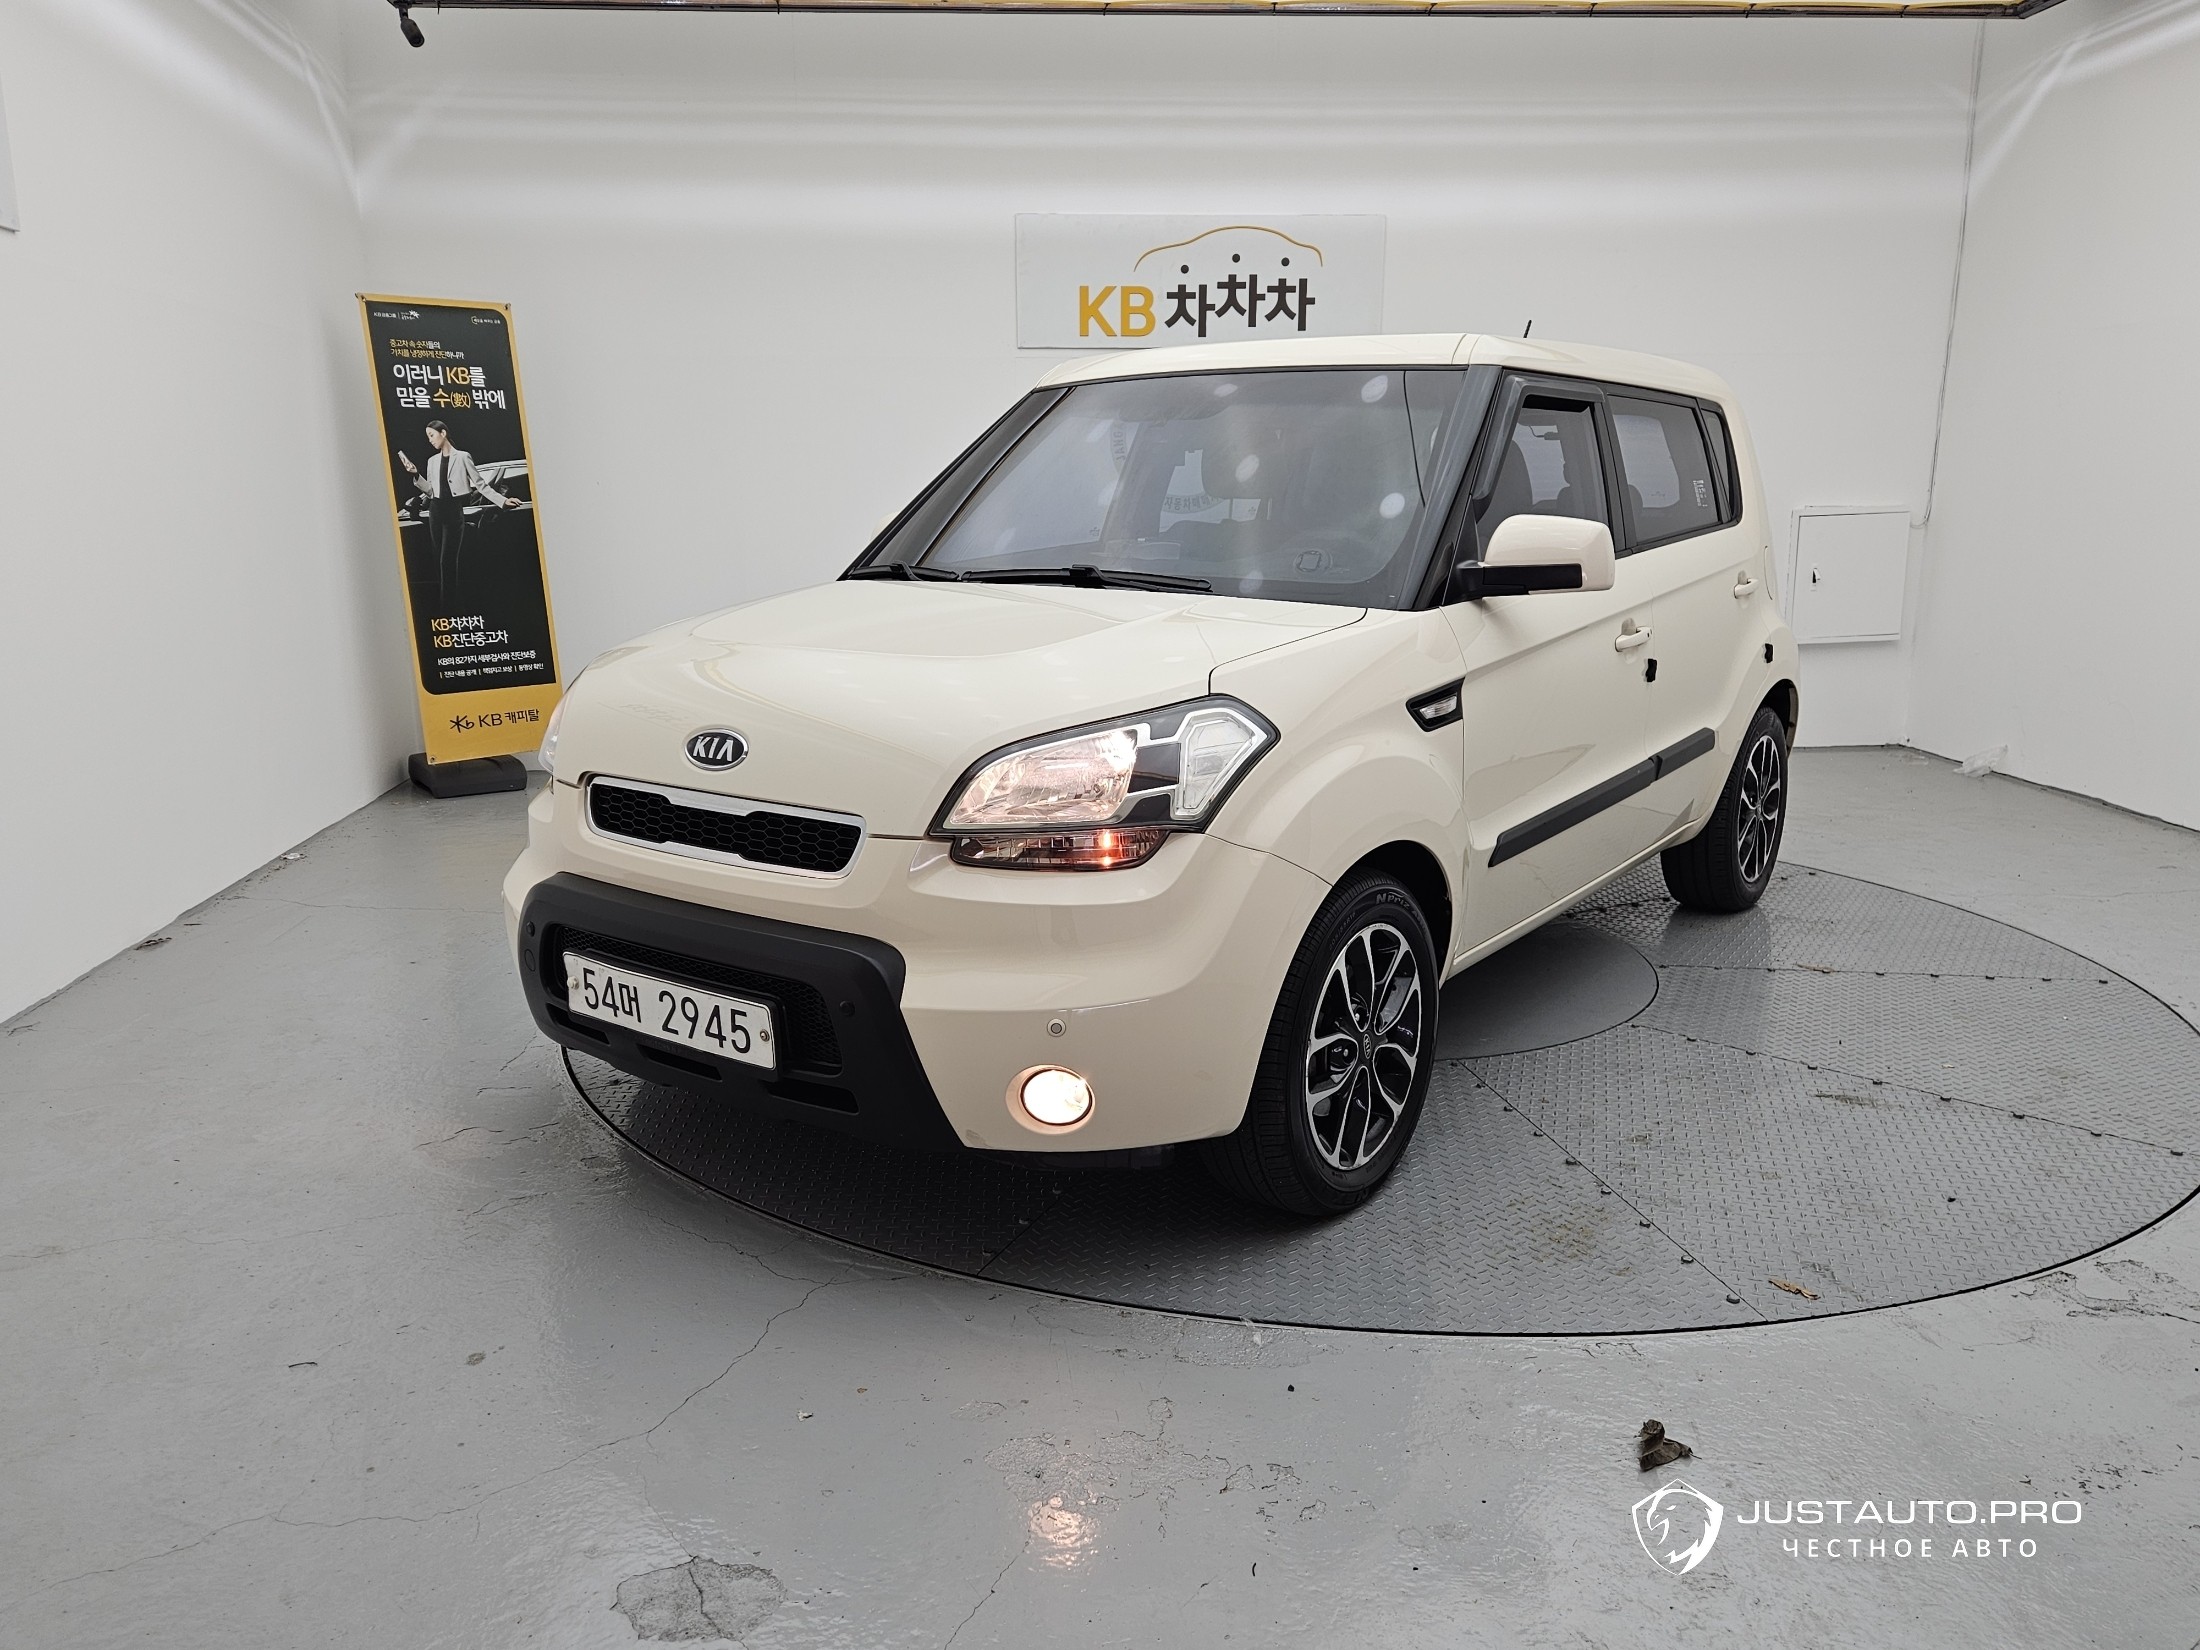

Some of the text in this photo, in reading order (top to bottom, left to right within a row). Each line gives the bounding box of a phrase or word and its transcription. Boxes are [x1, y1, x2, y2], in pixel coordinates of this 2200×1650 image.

[393, 363, 486, 388] 이러니 KB를
[396, 386, 431, 409] 믿을
[471, 389, 507, 410] 밖에
[431, 615, 485, 632] KB차차차
[433, 630, 509, 649] KB진단중고차
[437, 656, 455, 666] KB의
[692, 736, 734, 762] KIA
[582, 967, 751, 1054] 54머 2945
